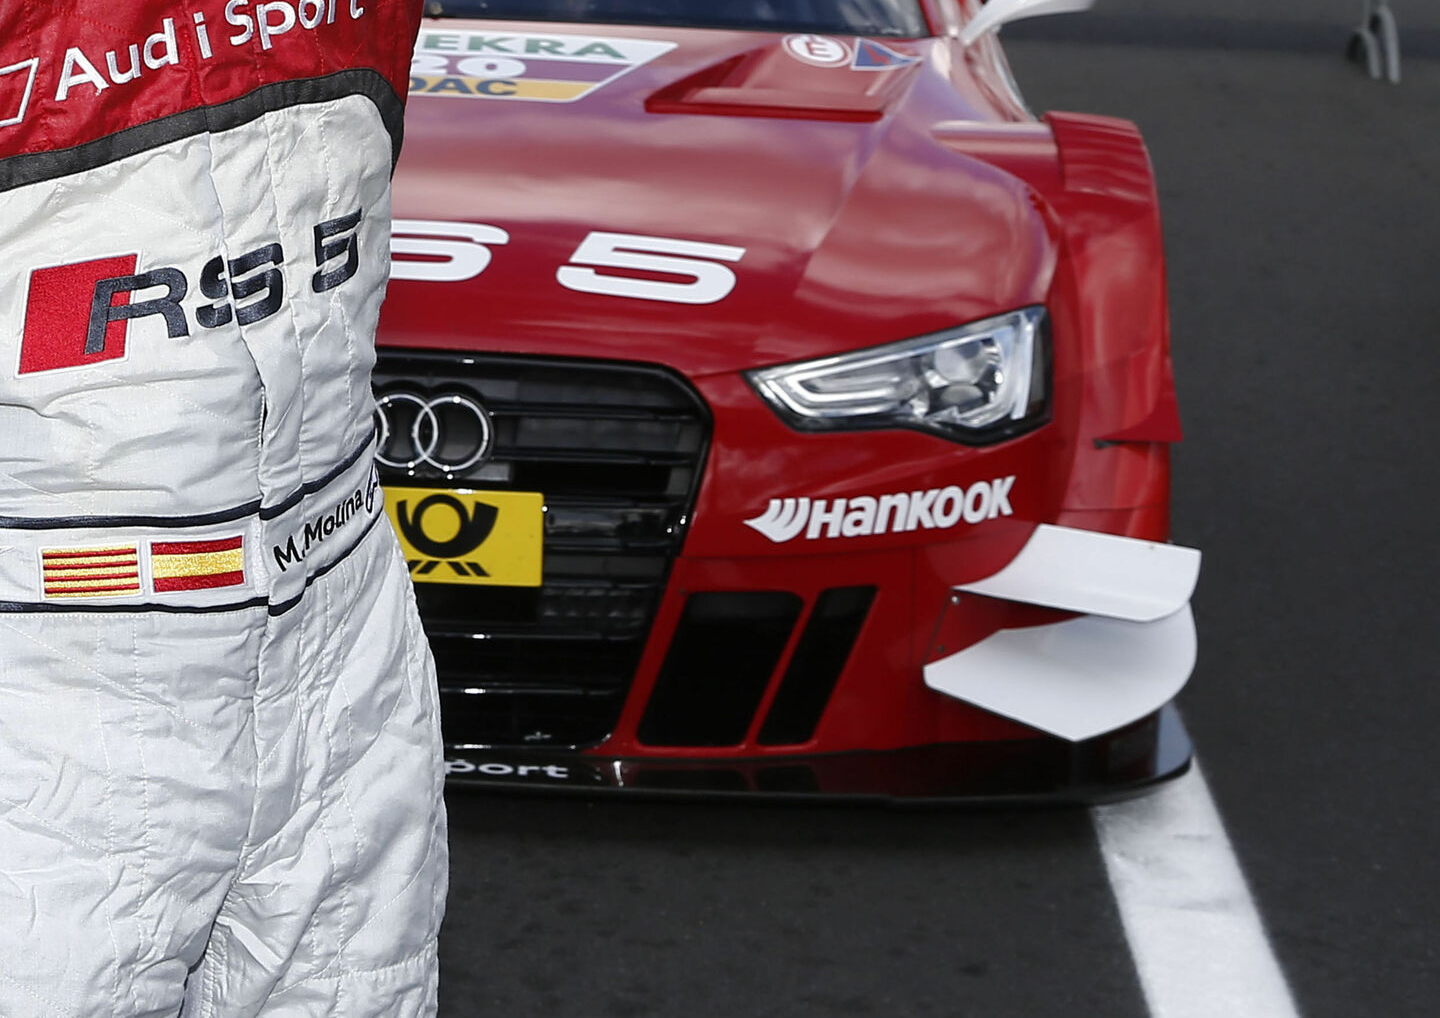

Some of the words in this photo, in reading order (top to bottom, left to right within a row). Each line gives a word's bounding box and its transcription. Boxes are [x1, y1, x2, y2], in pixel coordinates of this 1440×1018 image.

[54, 11, 214, 102] Audi
[423, 34, 628, 60] EKRA
[83, 242, 285, 356] RS
[313, 209, 362, 294] 5
[556, 230, 747, 305] 5
[445, 759, 569, 779] port
